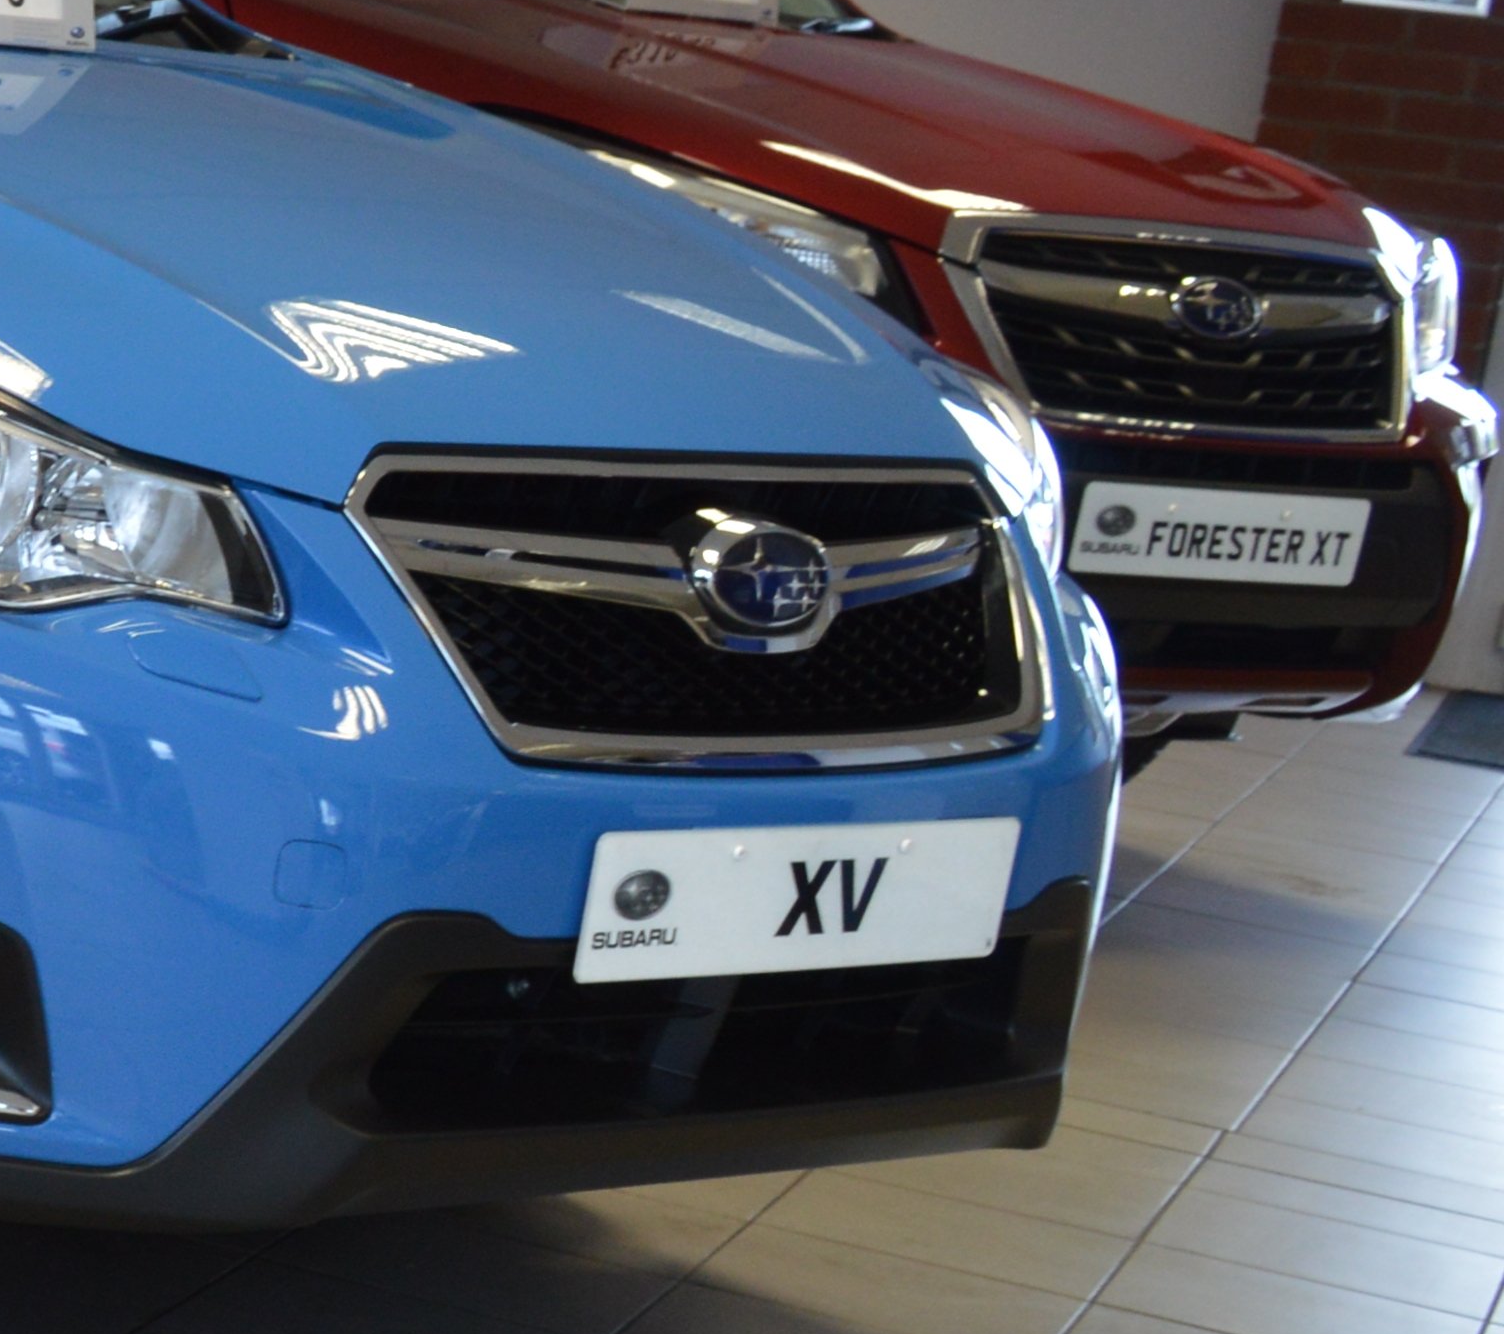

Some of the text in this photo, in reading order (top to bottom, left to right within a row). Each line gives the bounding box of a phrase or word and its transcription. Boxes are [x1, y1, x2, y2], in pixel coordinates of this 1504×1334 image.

[1080, 521, 1352, 567] SUBARU FORESTER XT
[591, 857, 890, 950] SUBARU XV
